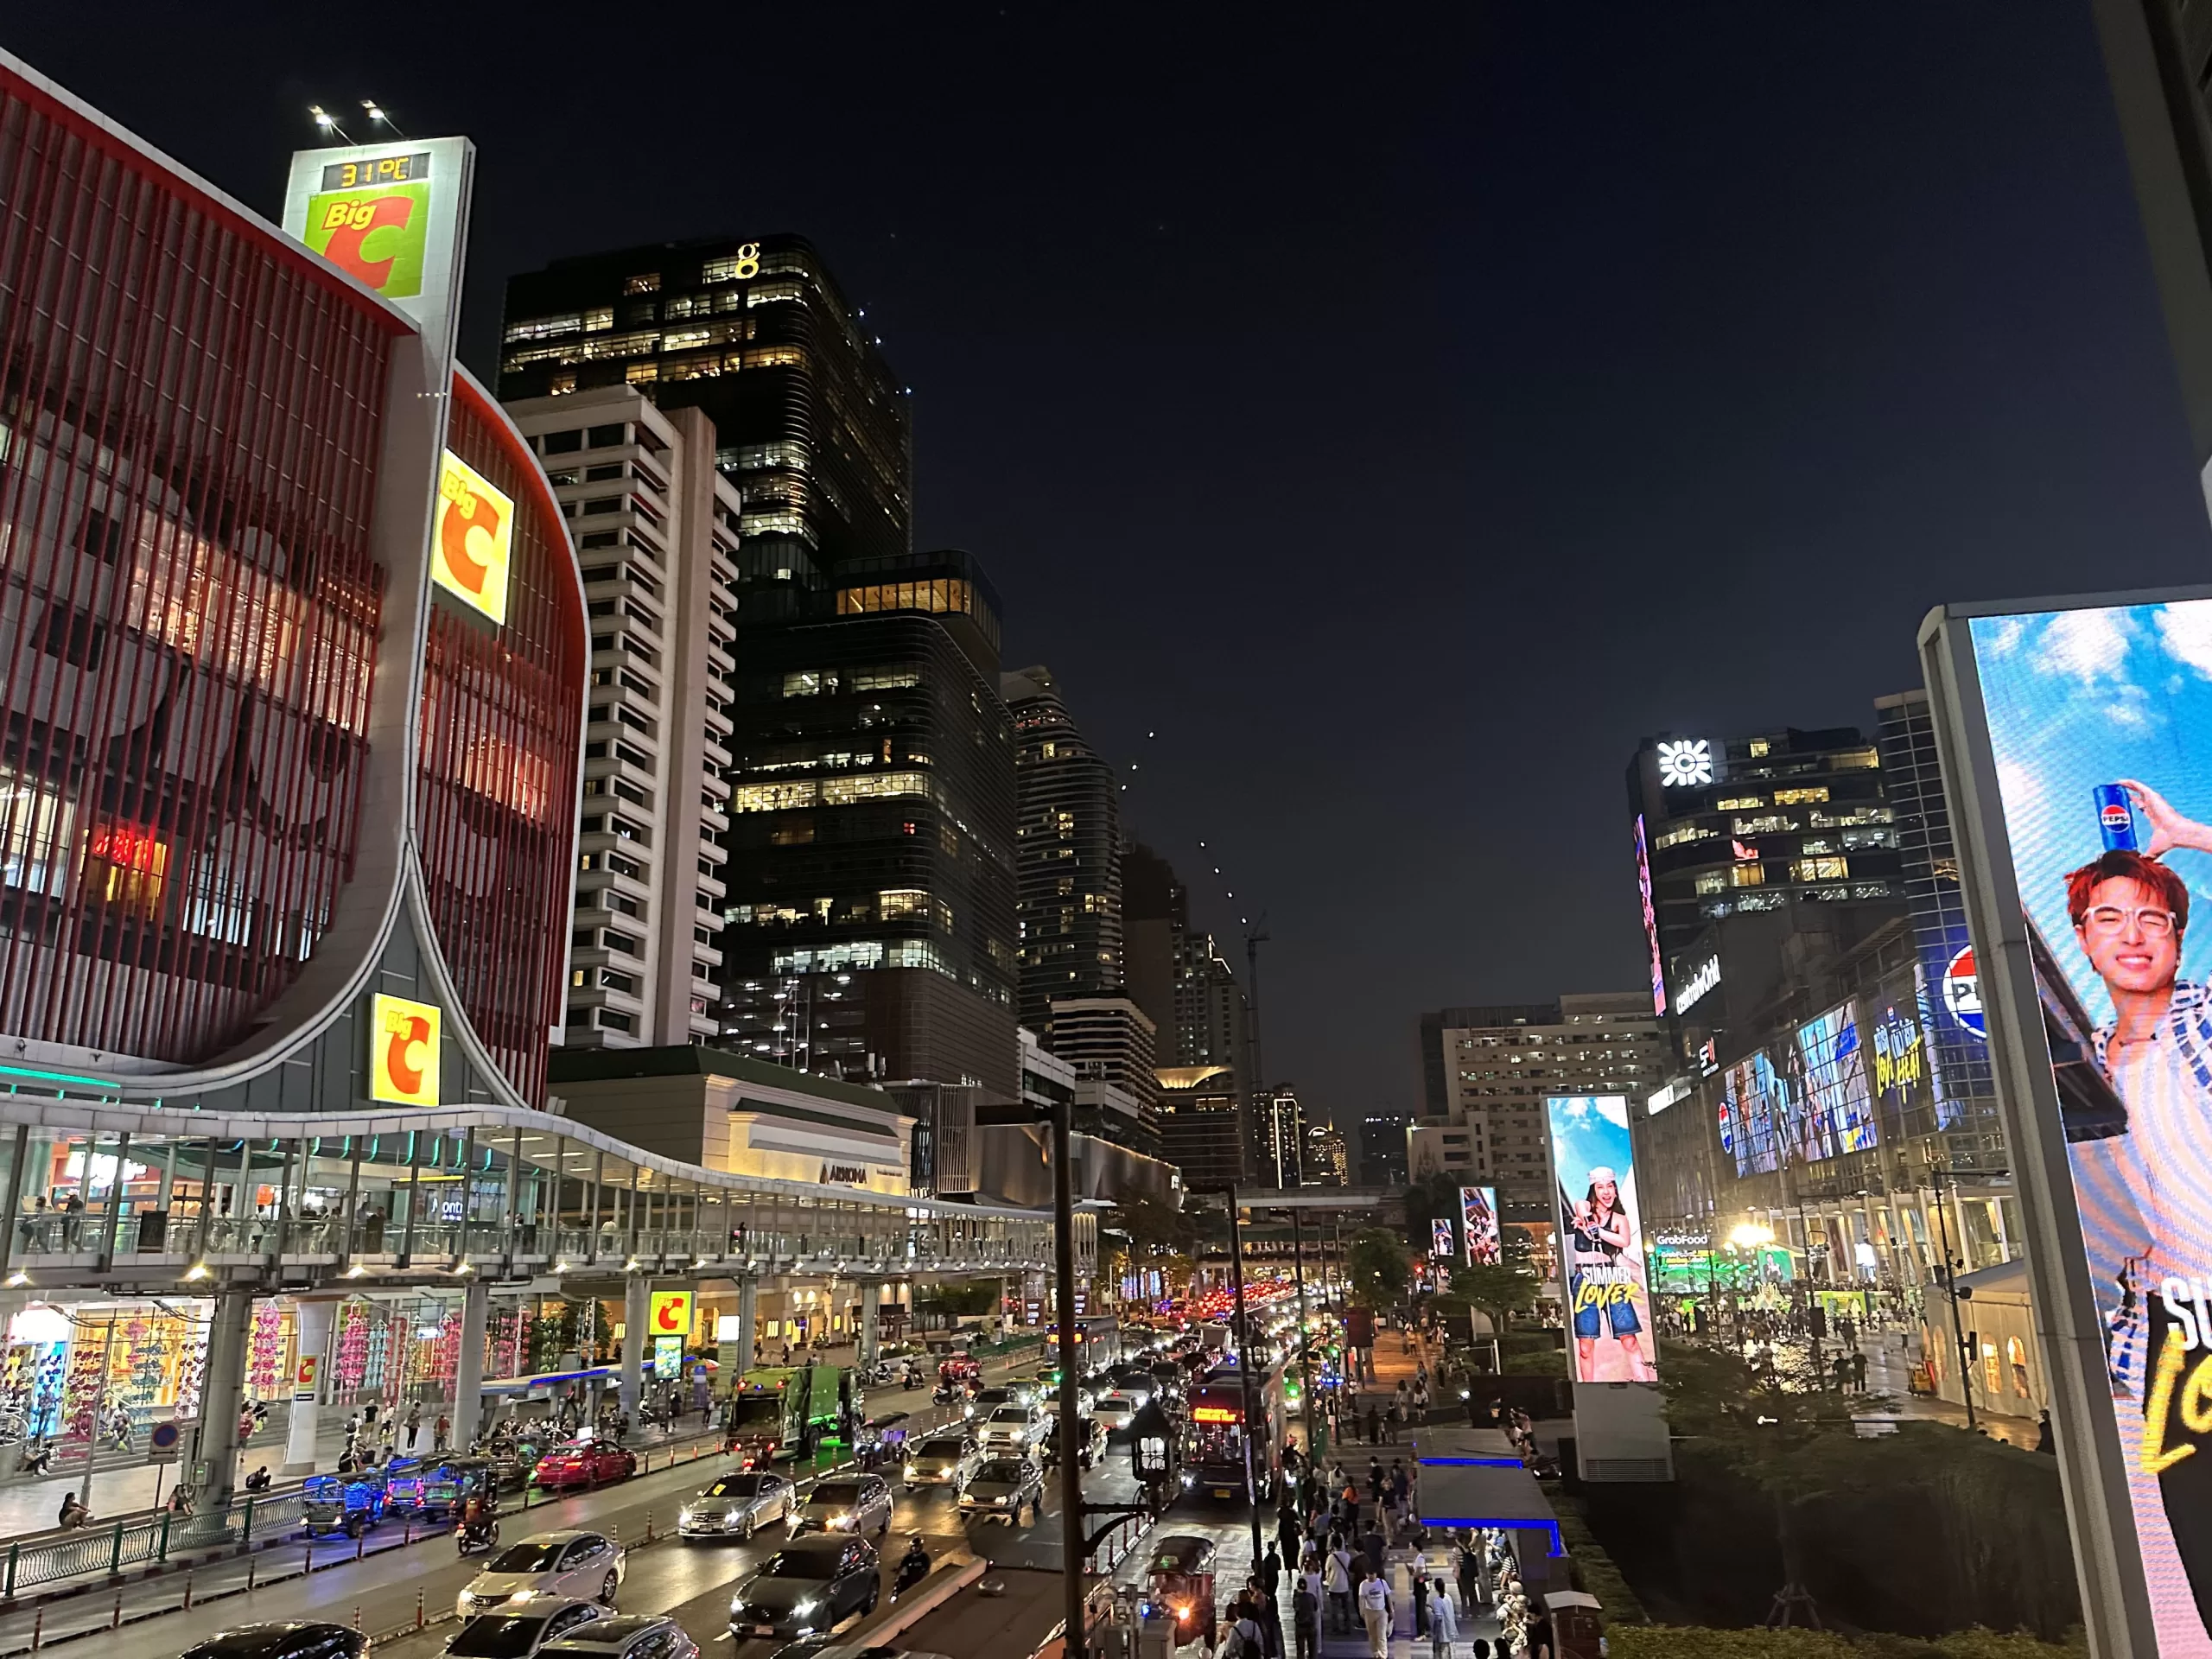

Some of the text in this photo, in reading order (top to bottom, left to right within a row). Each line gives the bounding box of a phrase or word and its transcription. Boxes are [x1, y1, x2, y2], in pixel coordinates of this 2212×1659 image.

[321, 199, 378, 231] Big
[324, 195, 415, 291] C
[440, 469, 478, 520] Big
[442, 491, 499, 594] C
[385, 1010, 413, 1040] Big
[387, 1016, 430, 1095] C
[1656, 1234, 1708, 1245] GrabFood
[1582, 1266, 1631, 1285] SUMMER
[657, 1297, 674, 1309] Big
[1574, 1278, 1645, 1314] LOVER
[658, 1297, 684, 1330] C
